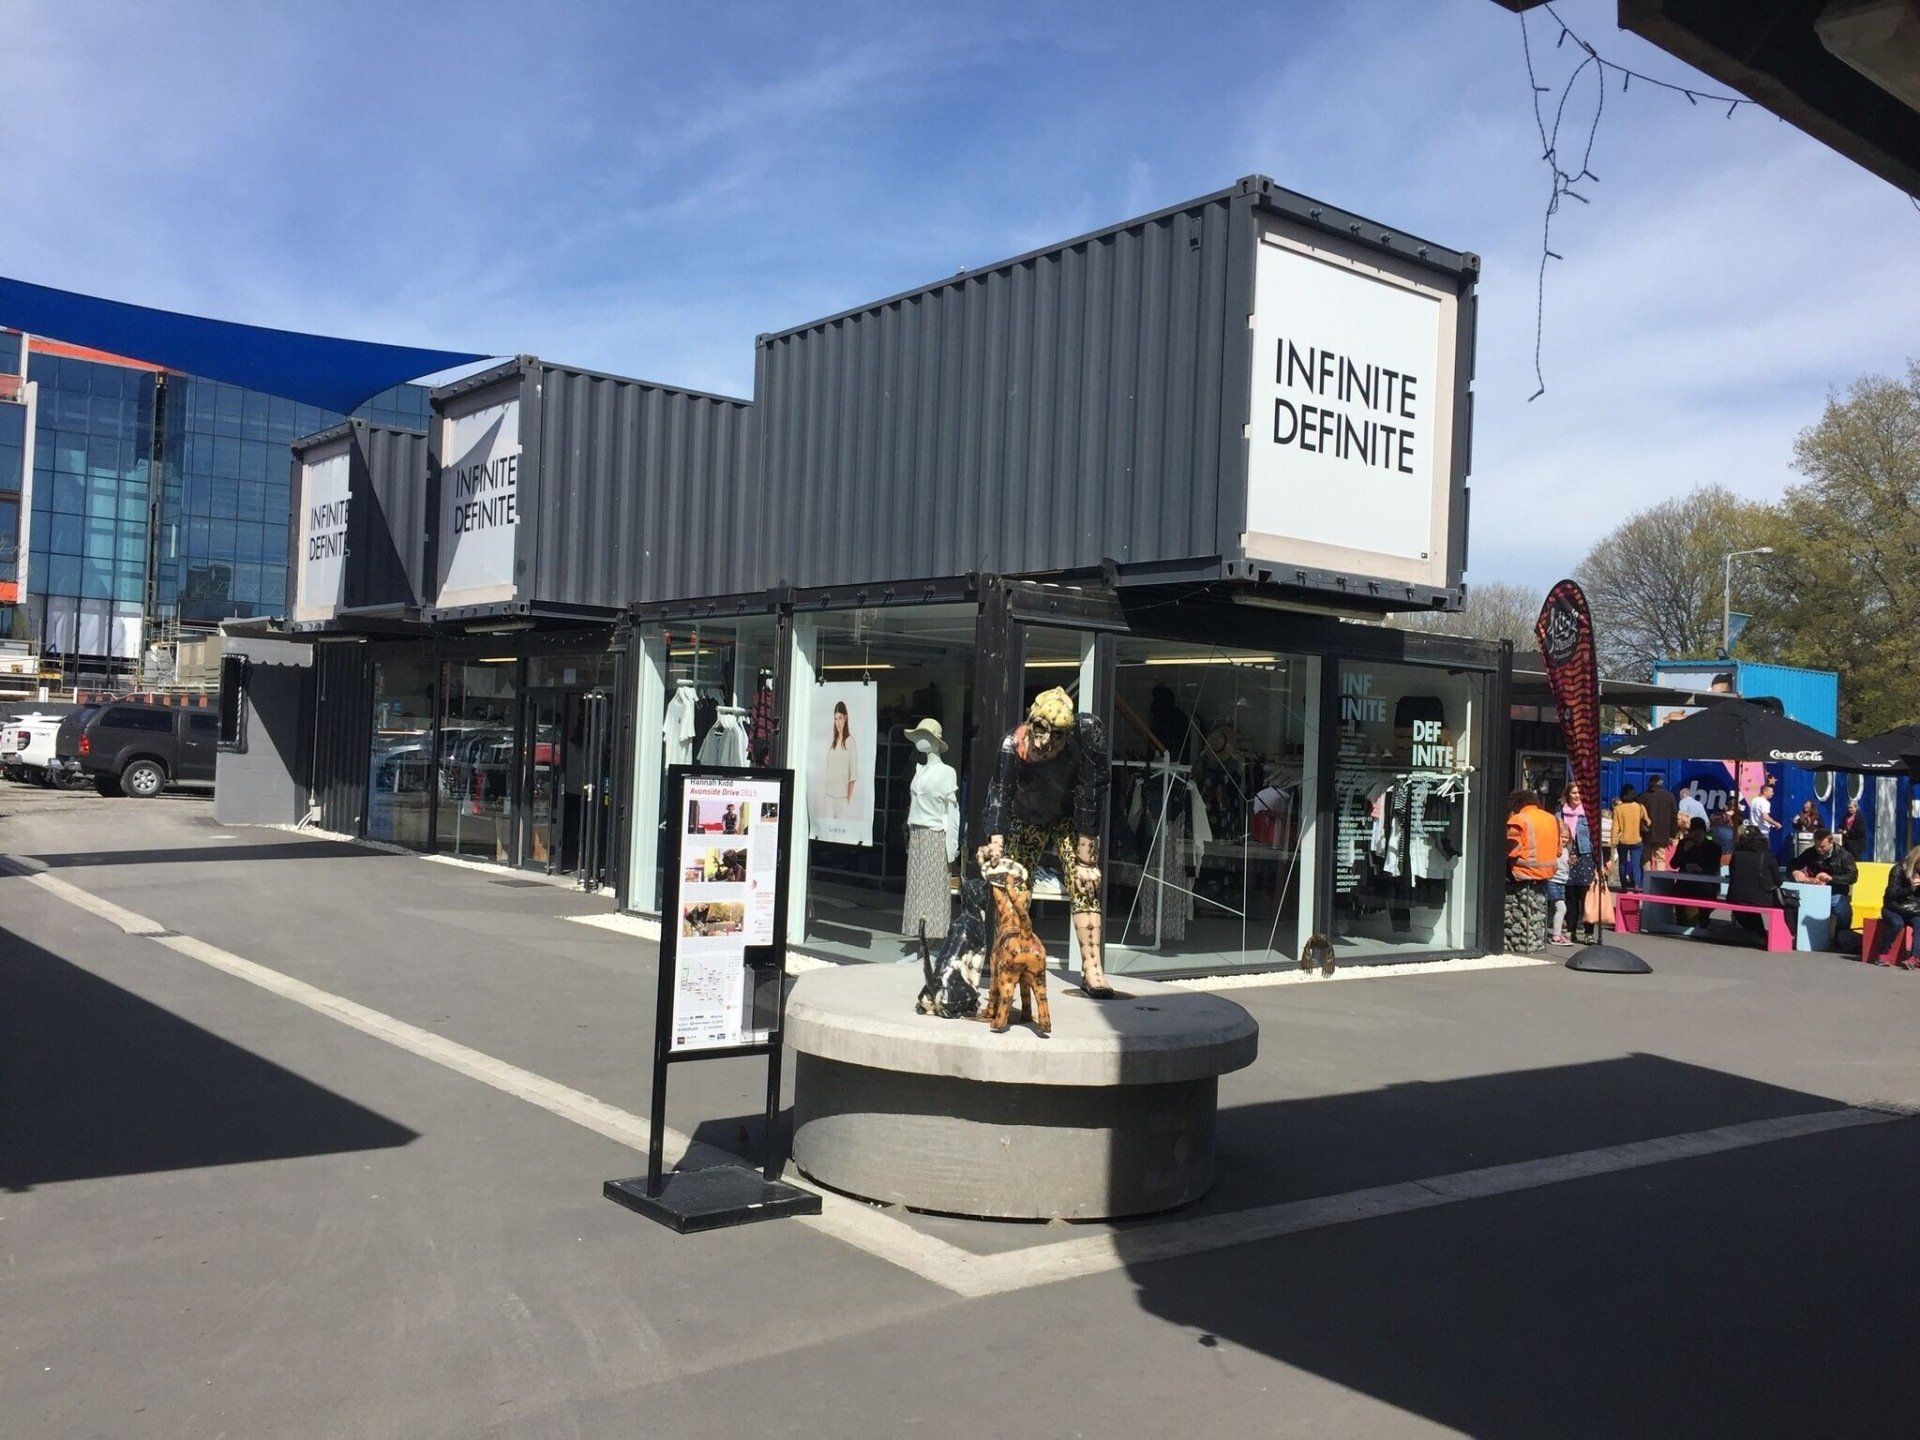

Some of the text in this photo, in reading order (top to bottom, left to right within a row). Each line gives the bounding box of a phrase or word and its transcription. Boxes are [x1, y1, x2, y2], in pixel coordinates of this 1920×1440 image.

[1275, 338, 1417, 420] INFINITE
[1273, 397, 1415, 475] DEFINITE
[456, 455, 516, 498] INFINITE
[311, 499, 348, 531] INFINITE
[454, 494, 515, 535] DEFINITE
[310, 530, 349, 561] DEFINITE
[1342, 672, 1373, 695] INF
[1341, 697, 1386, 723] INITE
[1412, 720, 1442, 743] DEF
[1412, 745, 1453, 768] INITE
[690, 778, 734, 787] Hannah Kidd
[690, 787, 758, 797] Avonside Drive 2015
